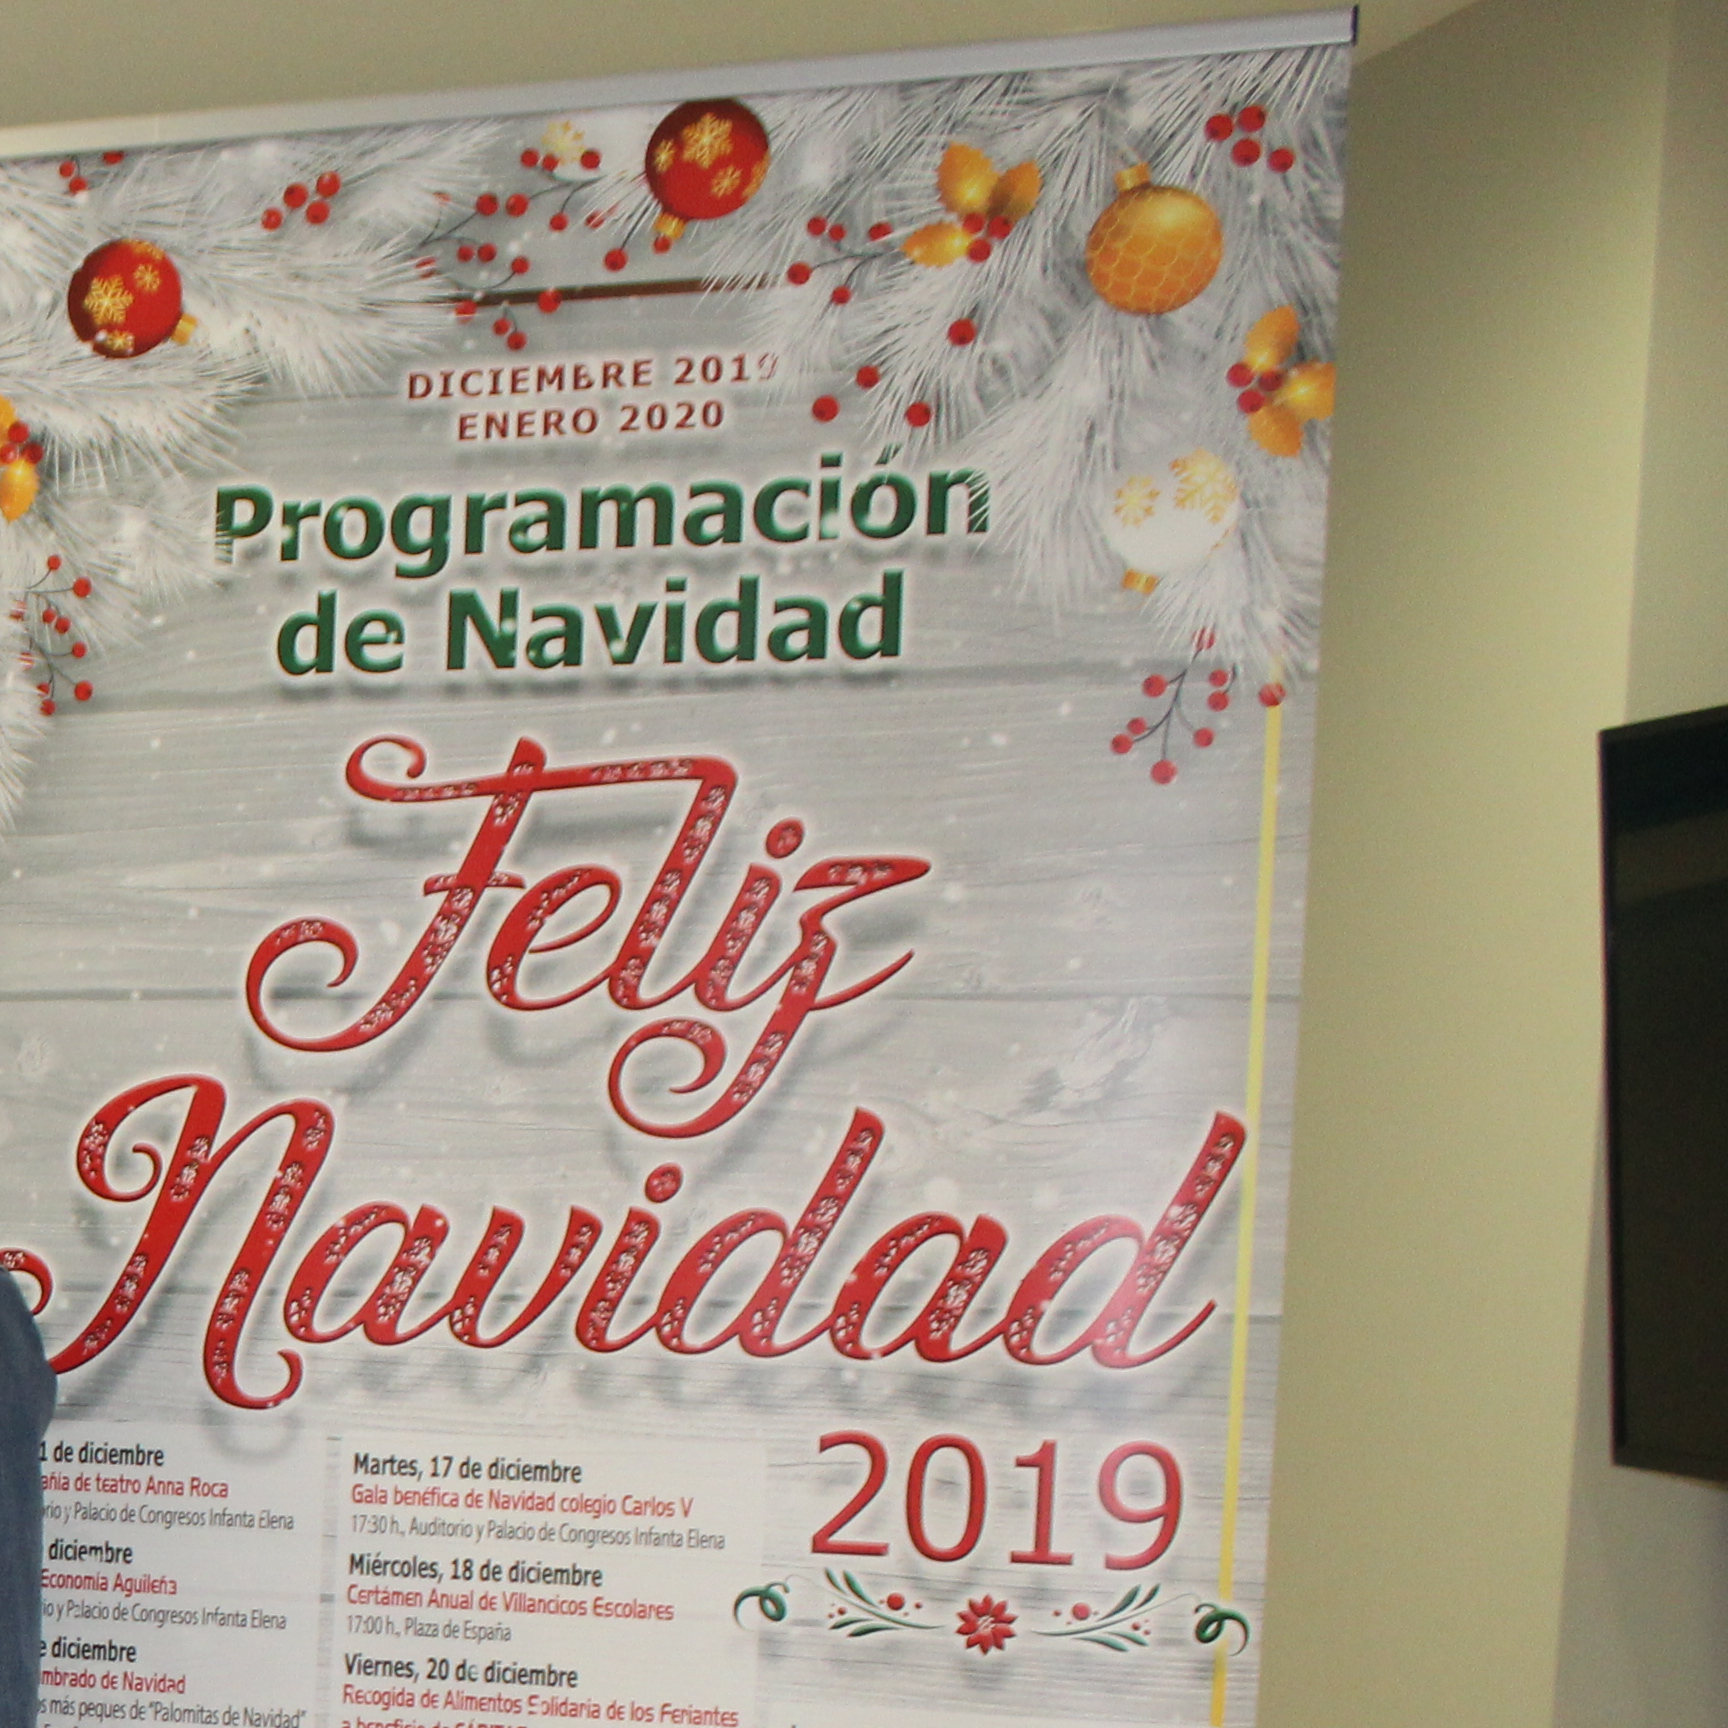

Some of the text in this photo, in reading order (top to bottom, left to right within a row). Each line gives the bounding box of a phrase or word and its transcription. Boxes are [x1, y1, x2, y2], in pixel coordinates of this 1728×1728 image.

[406, 351, 779, 402] DICIEMBRE 2019
[456, 400, 725, 443] ENERO 2020
[216, 443, 990, 577] Programación
[277, 569, 904, 677] de Navidad
[245, 733, 932, 1140] Feliz
[353, 1453, 582, 1483] Martes, 17 de diciembre
[810, 1428, 1184, 1572] 2019
[348, 1552, 602, 1587] Miércoles, 18 de diciembre
